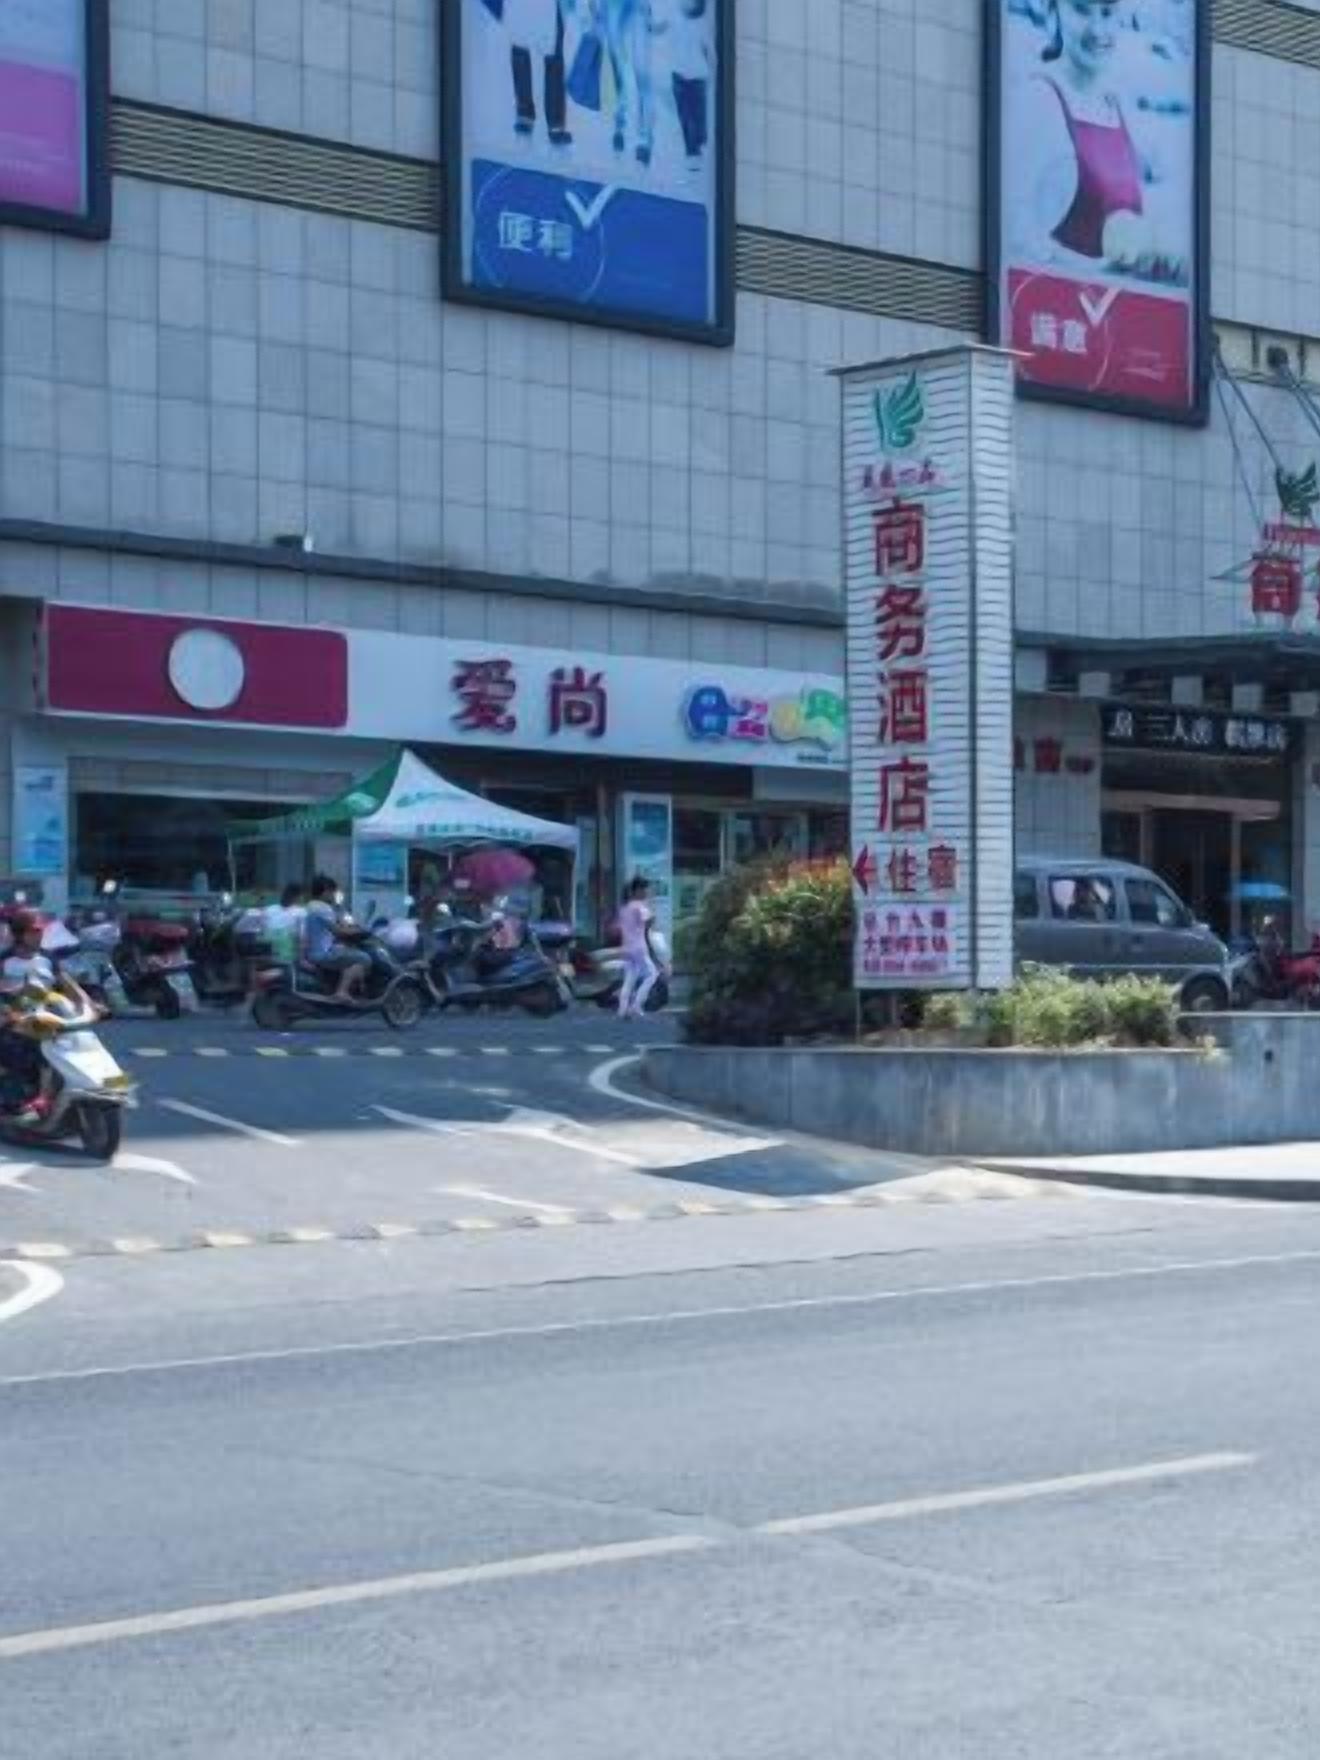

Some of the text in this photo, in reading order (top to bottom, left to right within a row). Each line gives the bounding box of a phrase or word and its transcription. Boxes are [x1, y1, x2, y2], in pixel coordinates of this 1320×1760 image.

[450, 659, 608, 738] 爱尚
[872, 497, 928, 832] 商务酒店
